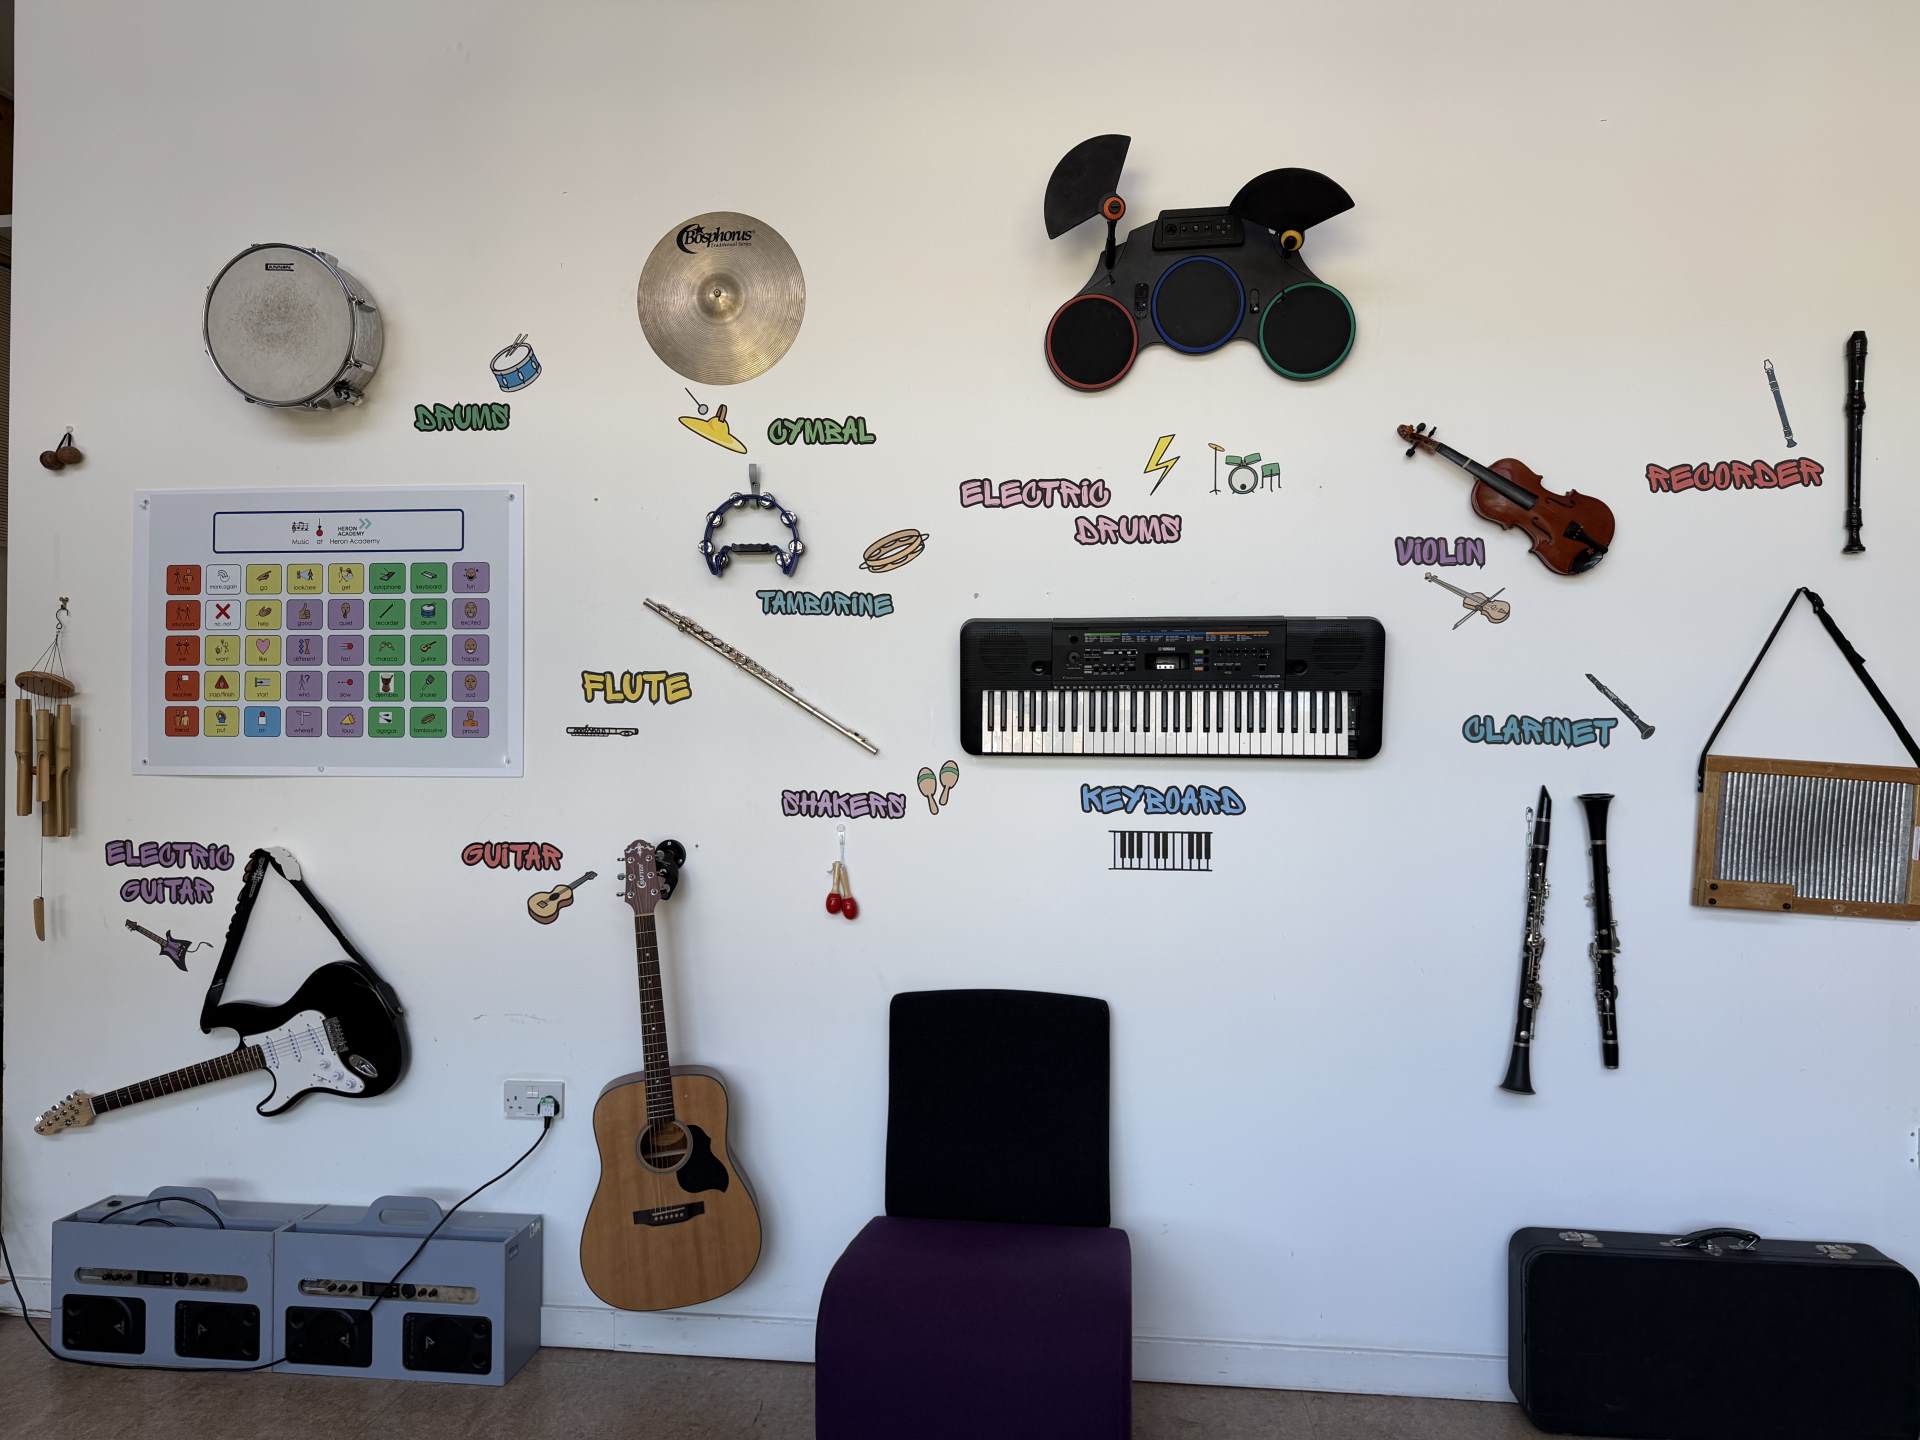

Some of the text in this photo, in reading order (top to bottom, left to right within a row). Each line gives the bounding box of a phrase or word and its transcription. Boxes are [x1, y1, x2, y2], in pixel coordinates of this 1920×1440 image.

[684, 227, 752, 247] Bosphorus
[414, 402, 510, 432] DRUMS
[767, 416, 876, 445] CYMBAL
[1645, 457, 1824, 493] RECORDER
[350, 538, 380, 546] Academy
[1074, 514, 1182, 545] DRUMS
[341, 584, 351, 592] get
[581, 670, 692, 705] FLUTE
[781, 790, 906, 819] SHAKERS
[1080, 783, 1246, 816] KEYBOARD
